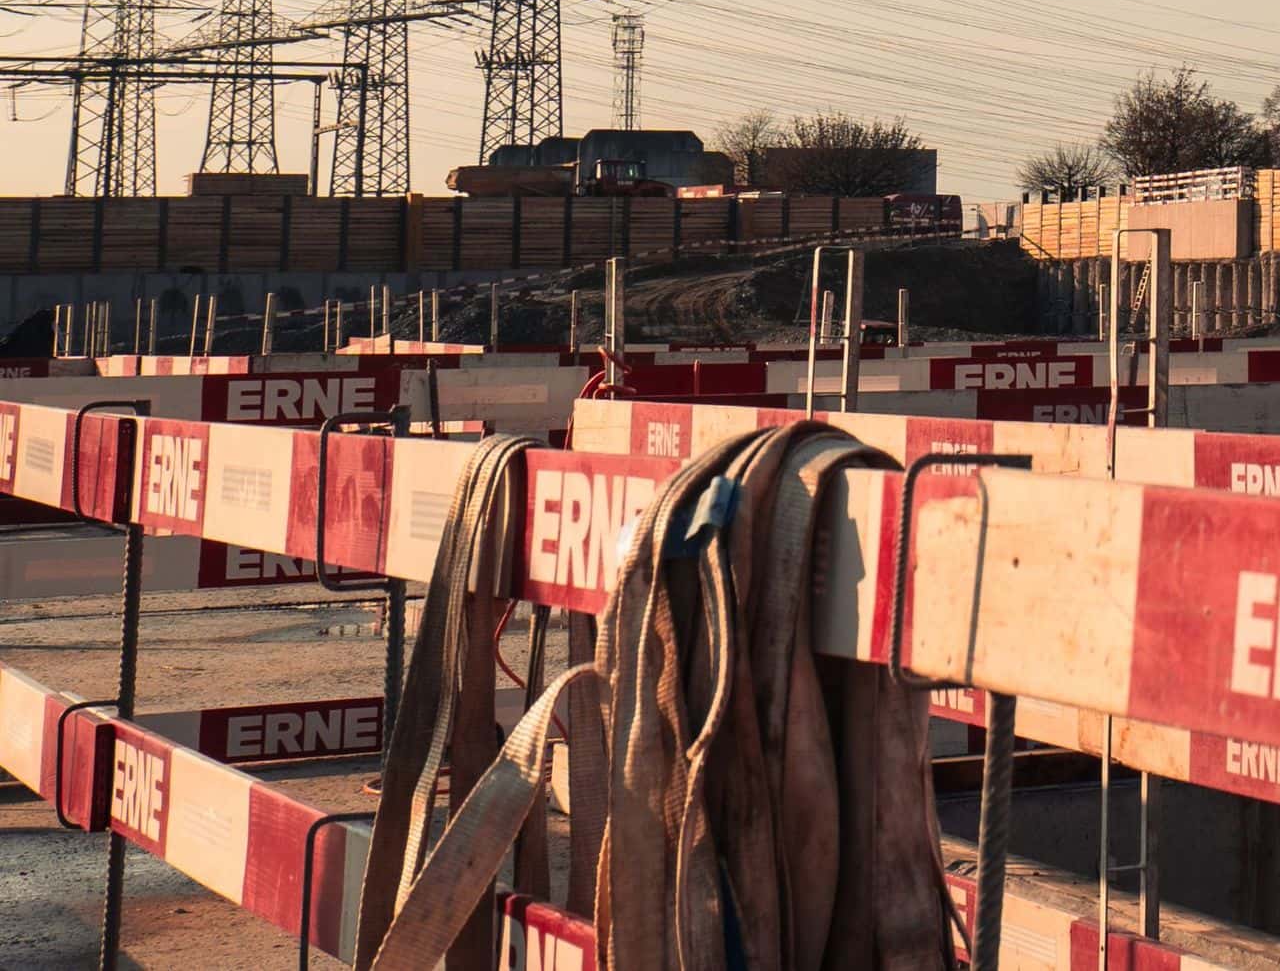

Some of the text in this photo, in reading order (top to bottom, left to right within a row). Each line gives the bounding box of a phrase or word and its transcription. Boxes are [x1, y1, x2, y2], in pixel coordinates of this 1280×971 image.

[955, 362, 1075, 389] ERNE
[226, 378, 375, 421] ERNE
[647, 422, 680, 457] ERNE
[146, 434, 201, 521] ERNE
[226, 707, 378, 758] ERNE
[111, 739, 164, 842] ERNE
